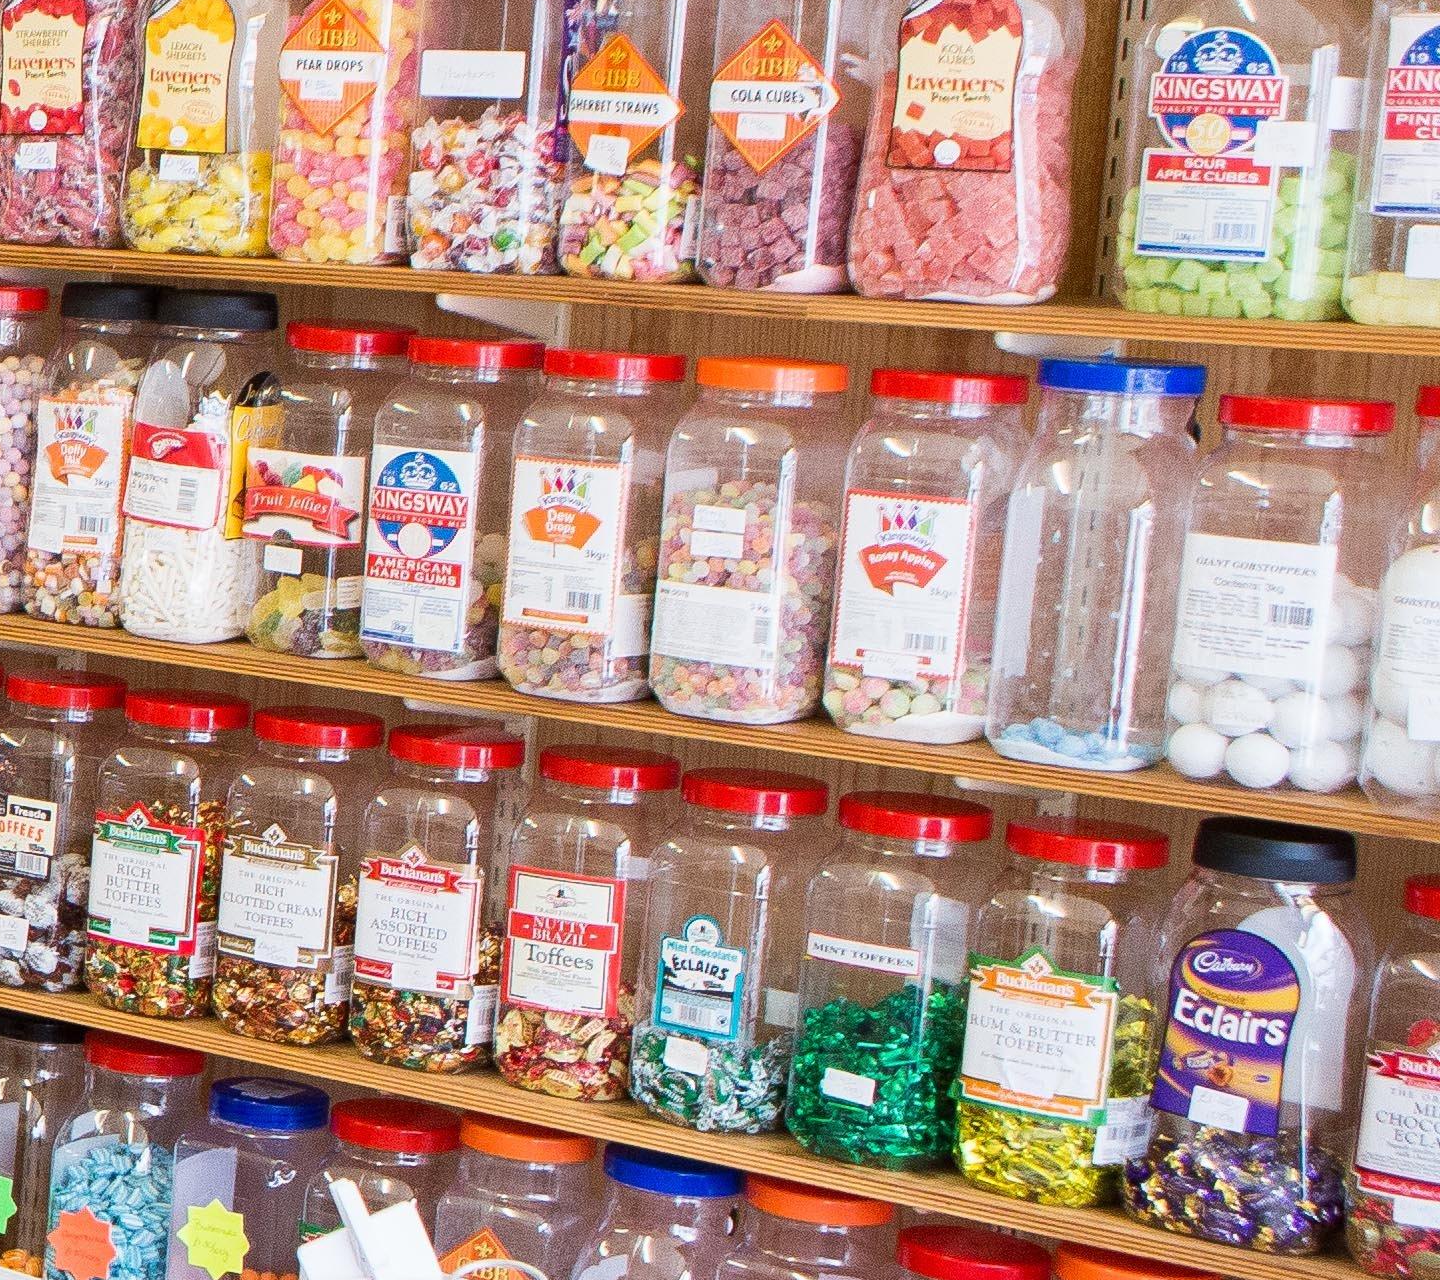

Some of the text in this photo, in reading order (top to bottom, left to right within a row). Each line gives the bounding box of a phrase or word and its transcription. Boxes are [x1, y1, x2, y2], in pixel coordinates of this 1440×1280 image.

[171, 40, 203, 52] LEMON
[307, 28, 357, 49] GIBB
[296, 58, 364, 73] PEAR DROPS
[591, 68, 640, 88] GIBB
[906, 70, 1005, 95] taveners
[731, 88, 805, 106] COLA CUBES
[1154, 76, 1283, 102] KINGSWAY
[570, 98, 659, 116] SHERBET STRAWS
[1184, 156, 1225, 170] SOUR
[1156, 169, 1259, 186] APPLE CUBES
[252, 490, 329, 517] Fruit Jellies
[372, 488, 468, 517] KINGSWAY
[373, 556, 452, 575] AMERICAN
[1194, 556, 1319, 578] GIANT GOBSTOPPERS
[369, 567, 458, 587] HARD GUMS
[116, 863, 151, 879] RICH
[106, 876, 160, 894] BUTTER
[253, 882, 284, 898] RICH
[104, 888, 161, 909] TOFFEES
[222, 892, 323, 918] CLOTTED CREAM
[244, 911, 294, 929] TOFFEES
[390, 906, 428, 925] RICH
[532, 916, 587, 933] NUTTY
[369, 916, 448, 941] ASSORTED
[531, 928, 586, 947] BRAZIL
[376, 933, 438, 954] TOFFEES
[524, 943, 594, 972] Toffees
[673, 953, 730, 981] ECLAIRS
[1192, 950, 1258, 979] Cadbury
[1174, 987, 1288, 1047] Eclairs
[993, 1033, 1064, 1059] TOFFEES
